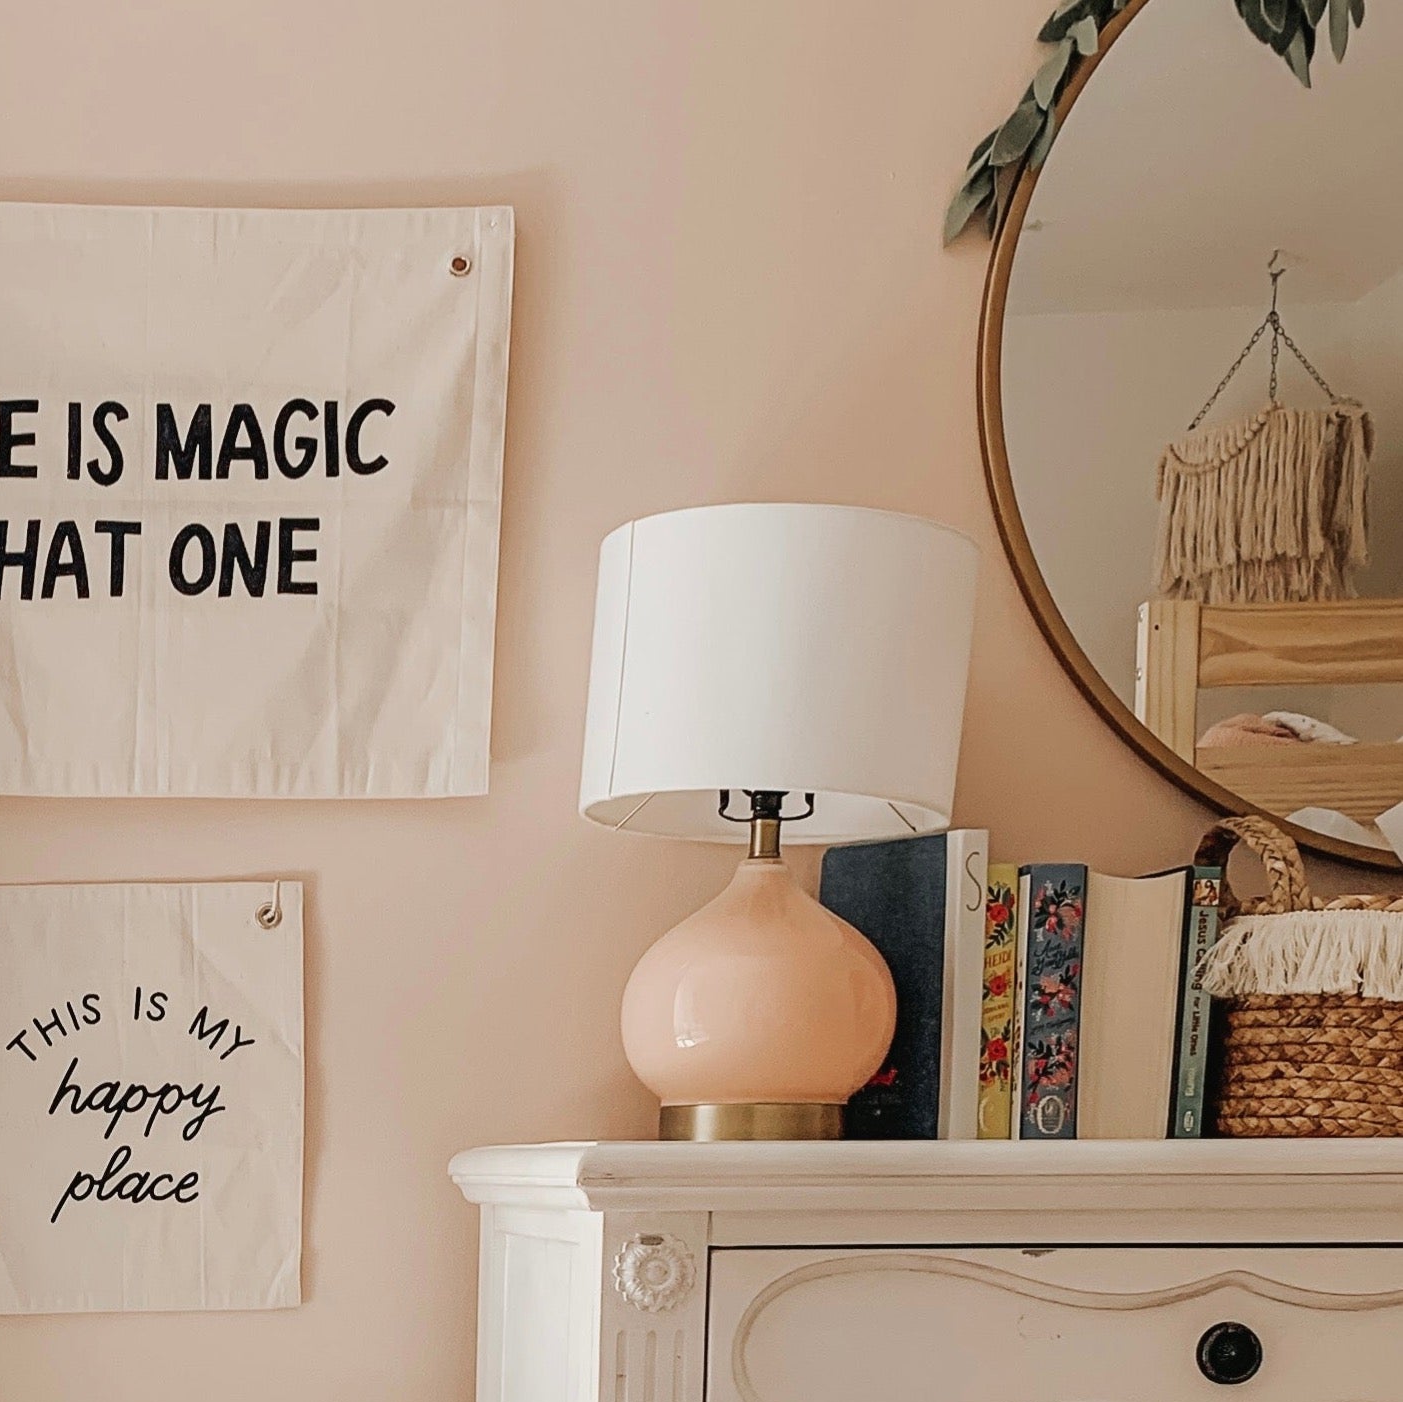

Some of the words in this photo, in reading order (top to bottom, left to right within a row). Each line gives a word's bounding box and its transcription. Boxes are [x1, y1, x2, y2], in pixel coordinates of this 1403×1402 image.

[67, 402, 128, 486] IS
[155, 399, 395, 480] MAGIC
[169, 518, 319, 597] ONE
[1197, 910, 1209, 945] Jesus
[6, 994, 100, 1065] THIS
[134, 987, 167, 1021] IS
[189, 1006, 255, 1059] MY
[48, 1057, 226, 1141] happy
[51, 1146, 198, 1223] place
